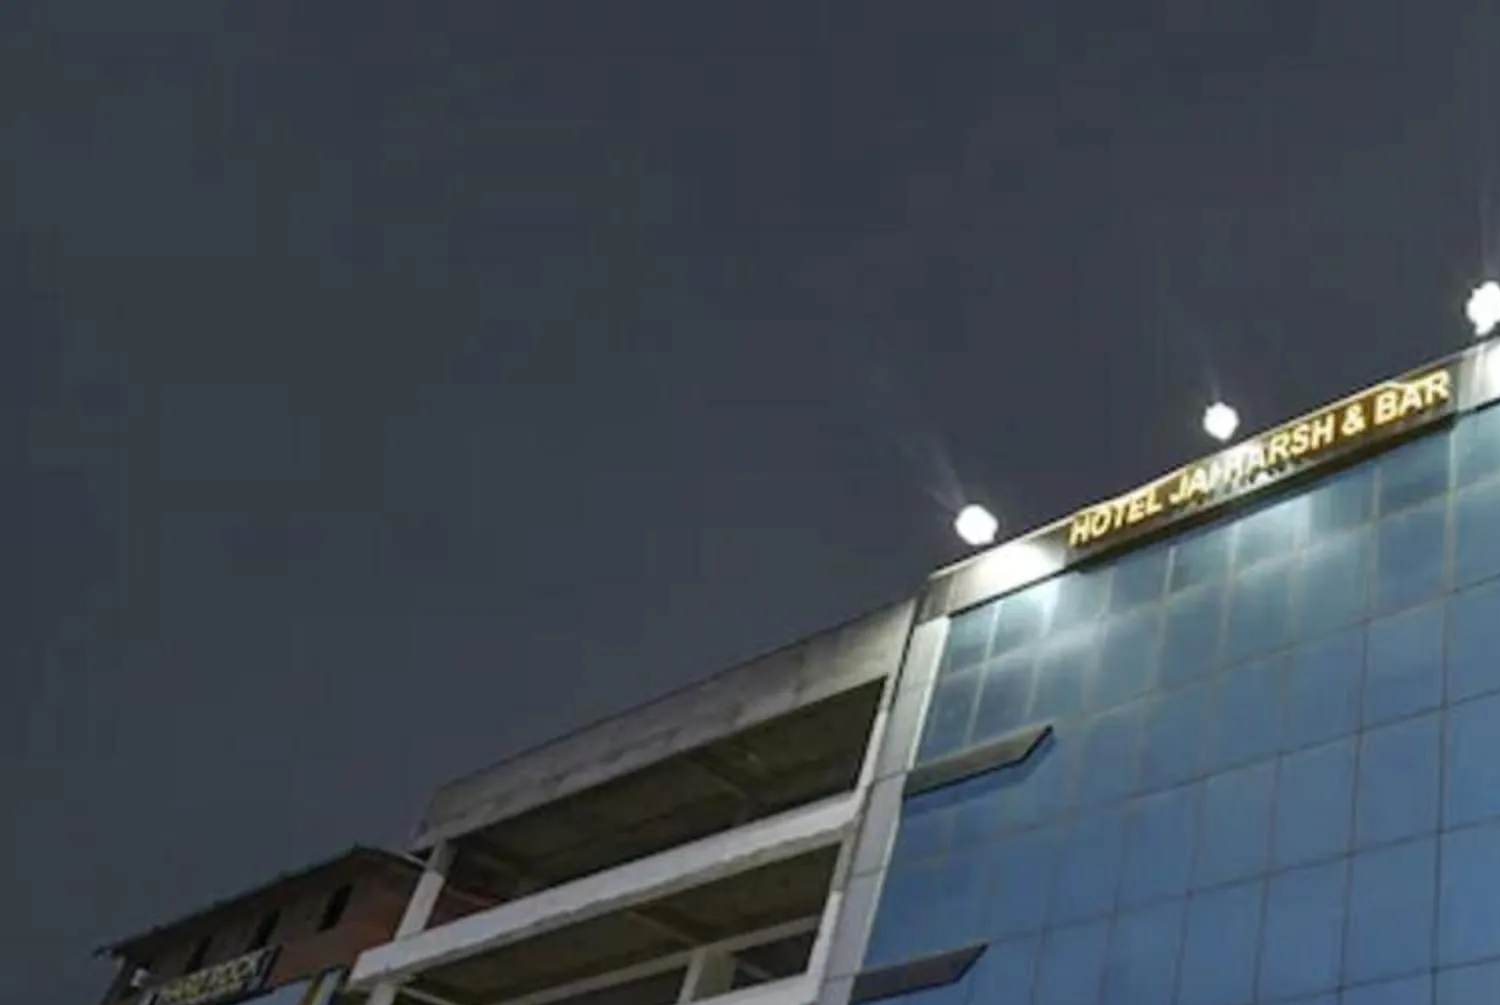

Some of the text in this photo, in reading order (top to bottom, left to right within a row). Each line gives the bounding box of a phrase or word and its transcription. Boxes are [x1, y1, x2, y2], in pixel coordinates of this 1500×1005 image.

[1068, 489, 1164, 547] HOTEL
[1341, 405, 1367, 436] &
[1373, 368, 1452, 425] BAR
